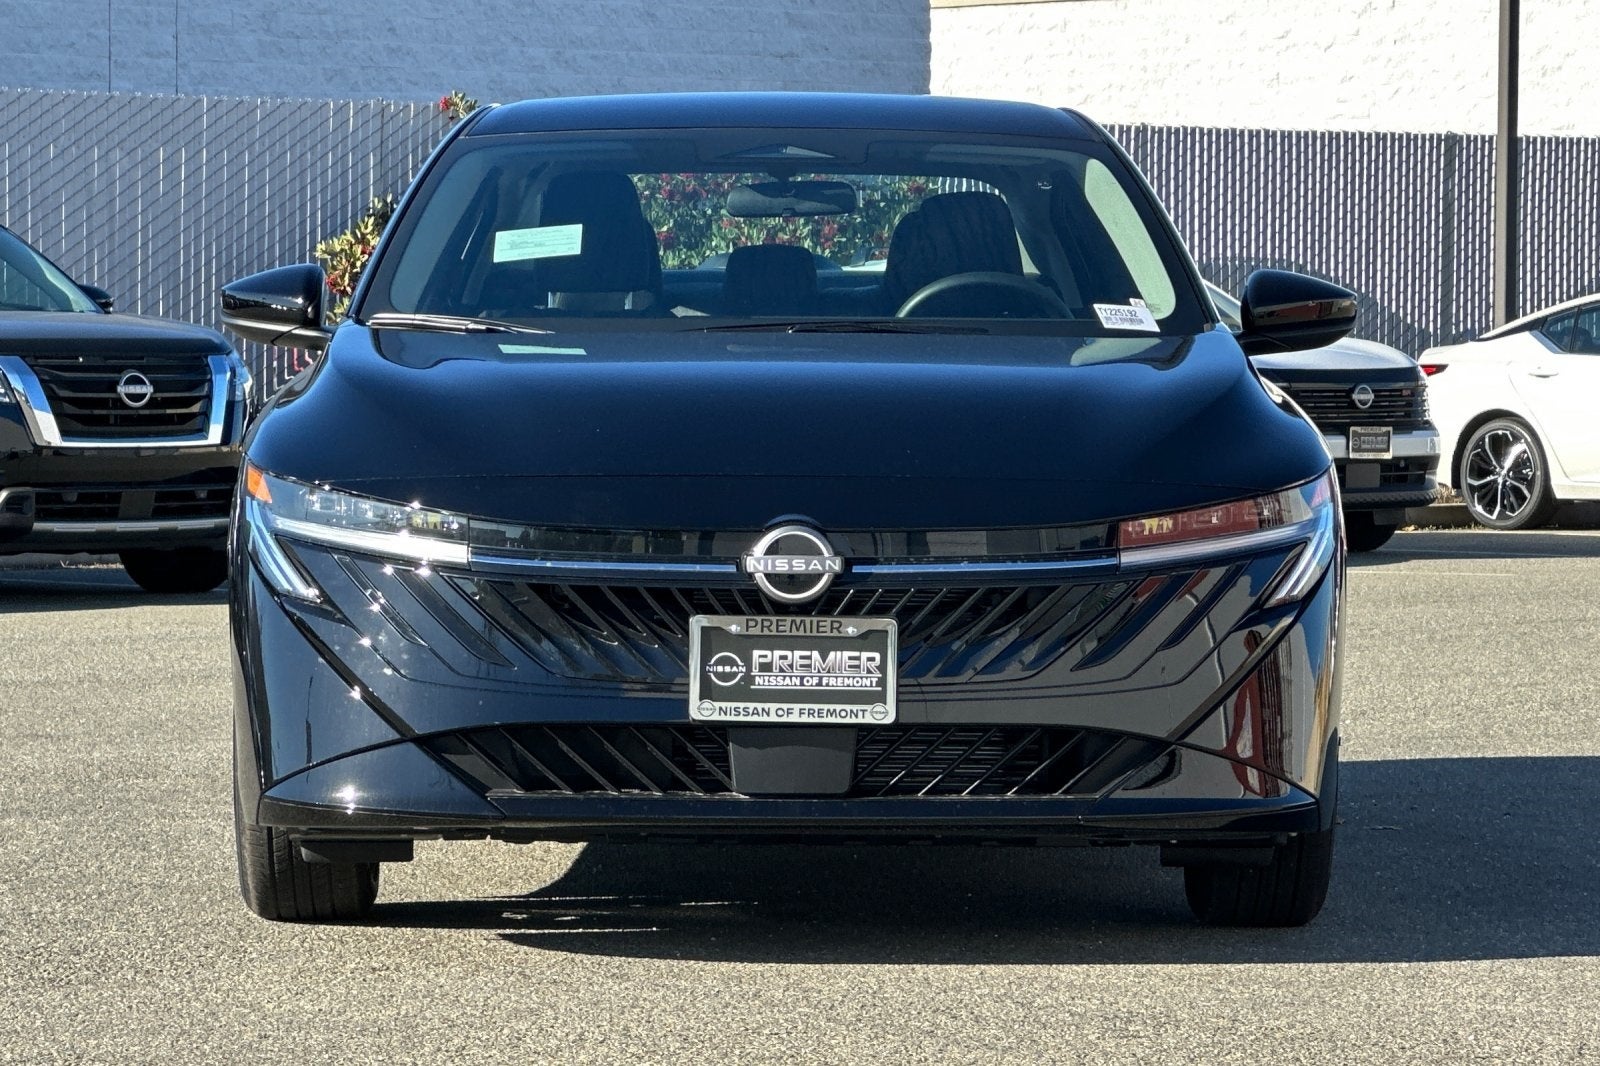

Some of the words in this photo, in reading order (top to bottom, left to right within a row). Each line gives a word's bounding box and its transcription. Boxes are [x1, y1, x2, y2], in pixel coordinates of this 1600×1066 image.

[750, 559, 840, 571] NISSAN
[745, 618, 843, 634] PREMIER
[752, 650, 881, 674] PREMIER
[706, 665, 746, 673] NISSAN
[755, 676, 800, 686] NISSAN
[803, 676, 819, 686] OF
[822, 676, 878, 687] FREMONT
[719, 707, 770, 717] NISSAN
[775, 708, 794, 718] OF
[799, 708, 868, 719] FREMONT
